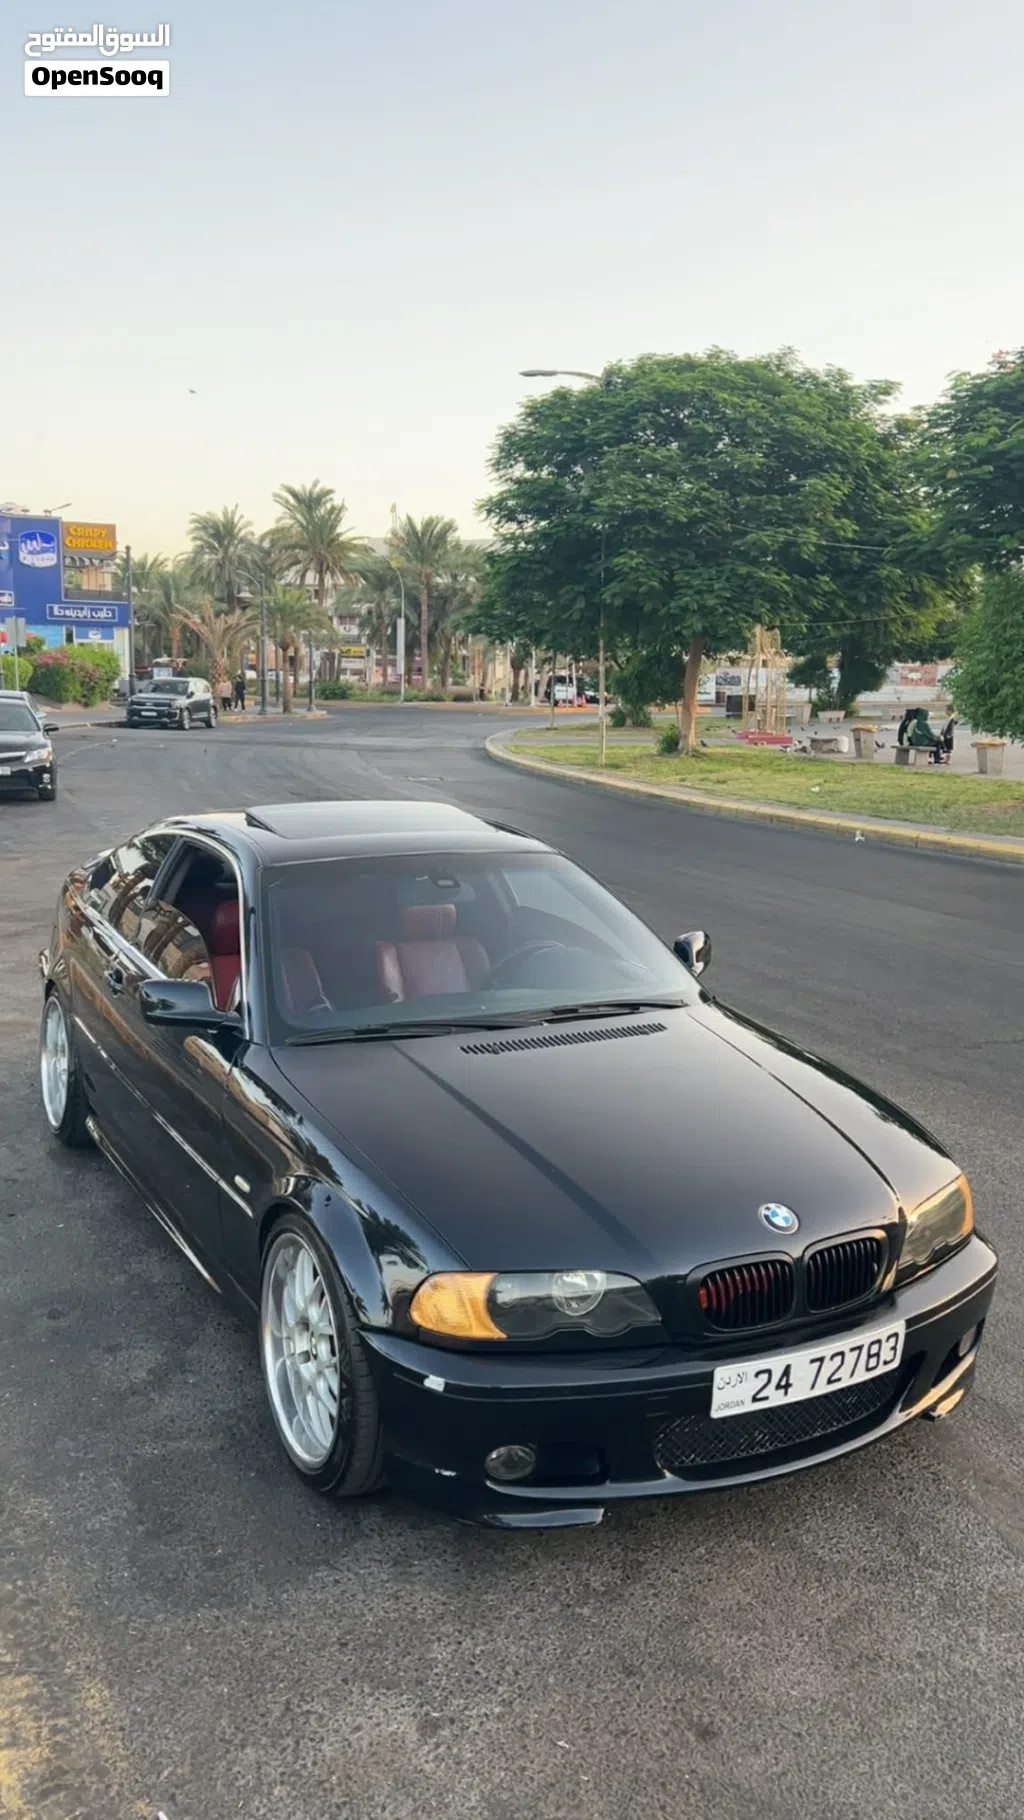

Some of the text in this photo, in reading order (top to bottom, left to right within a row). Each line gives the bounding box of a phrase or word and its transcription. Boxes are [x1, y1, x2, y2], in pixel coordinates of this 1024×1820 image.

[69, 525, 108, 537] CRISPY
[64, 536, 113, 549] CHICKEN
[751, 1331, 900, 1403] 24 72783
[715, 1399, 745, 1412] JORDAN
